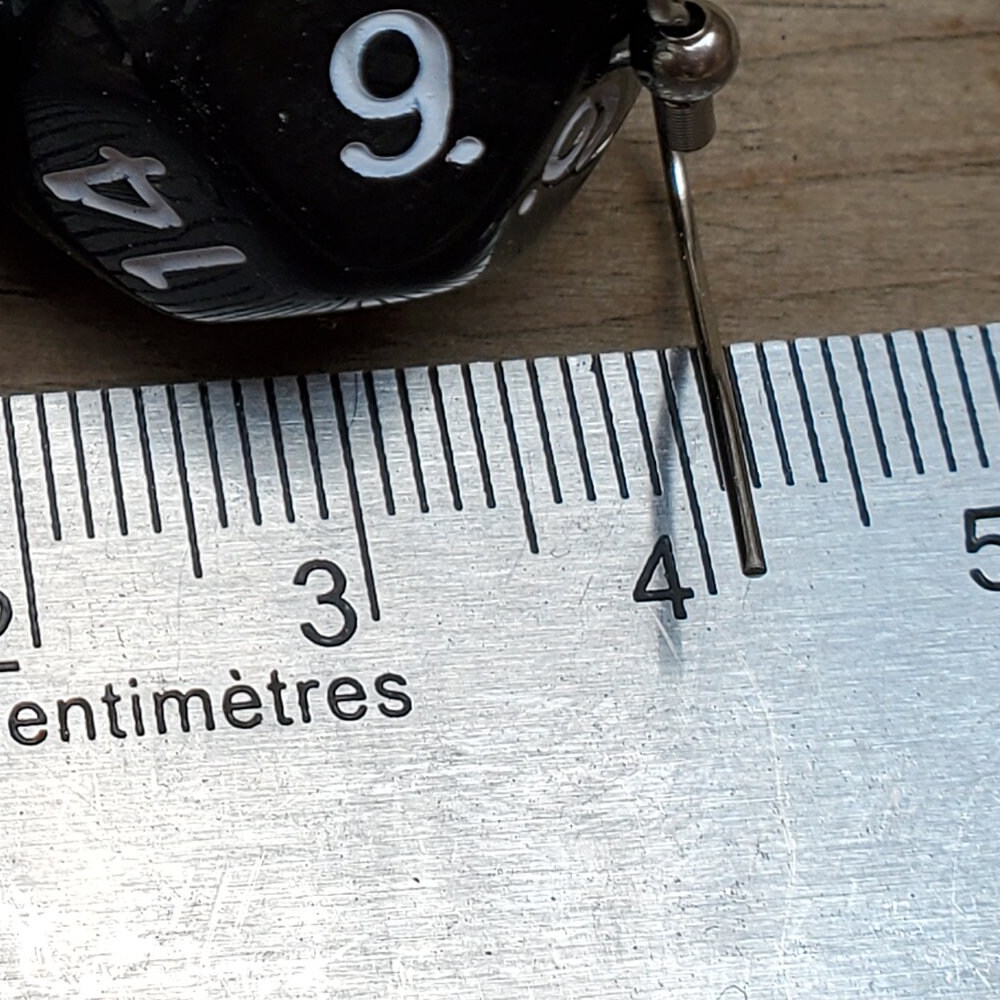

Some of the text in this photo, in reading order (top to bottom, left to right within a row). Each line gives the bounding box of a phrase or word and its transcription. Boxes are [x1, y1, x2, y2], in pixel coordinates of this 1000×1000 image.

[294, 560, 357, 647] 3
[633, 535, 694, 620] 4
[965, 507, 1000, 591] 5
